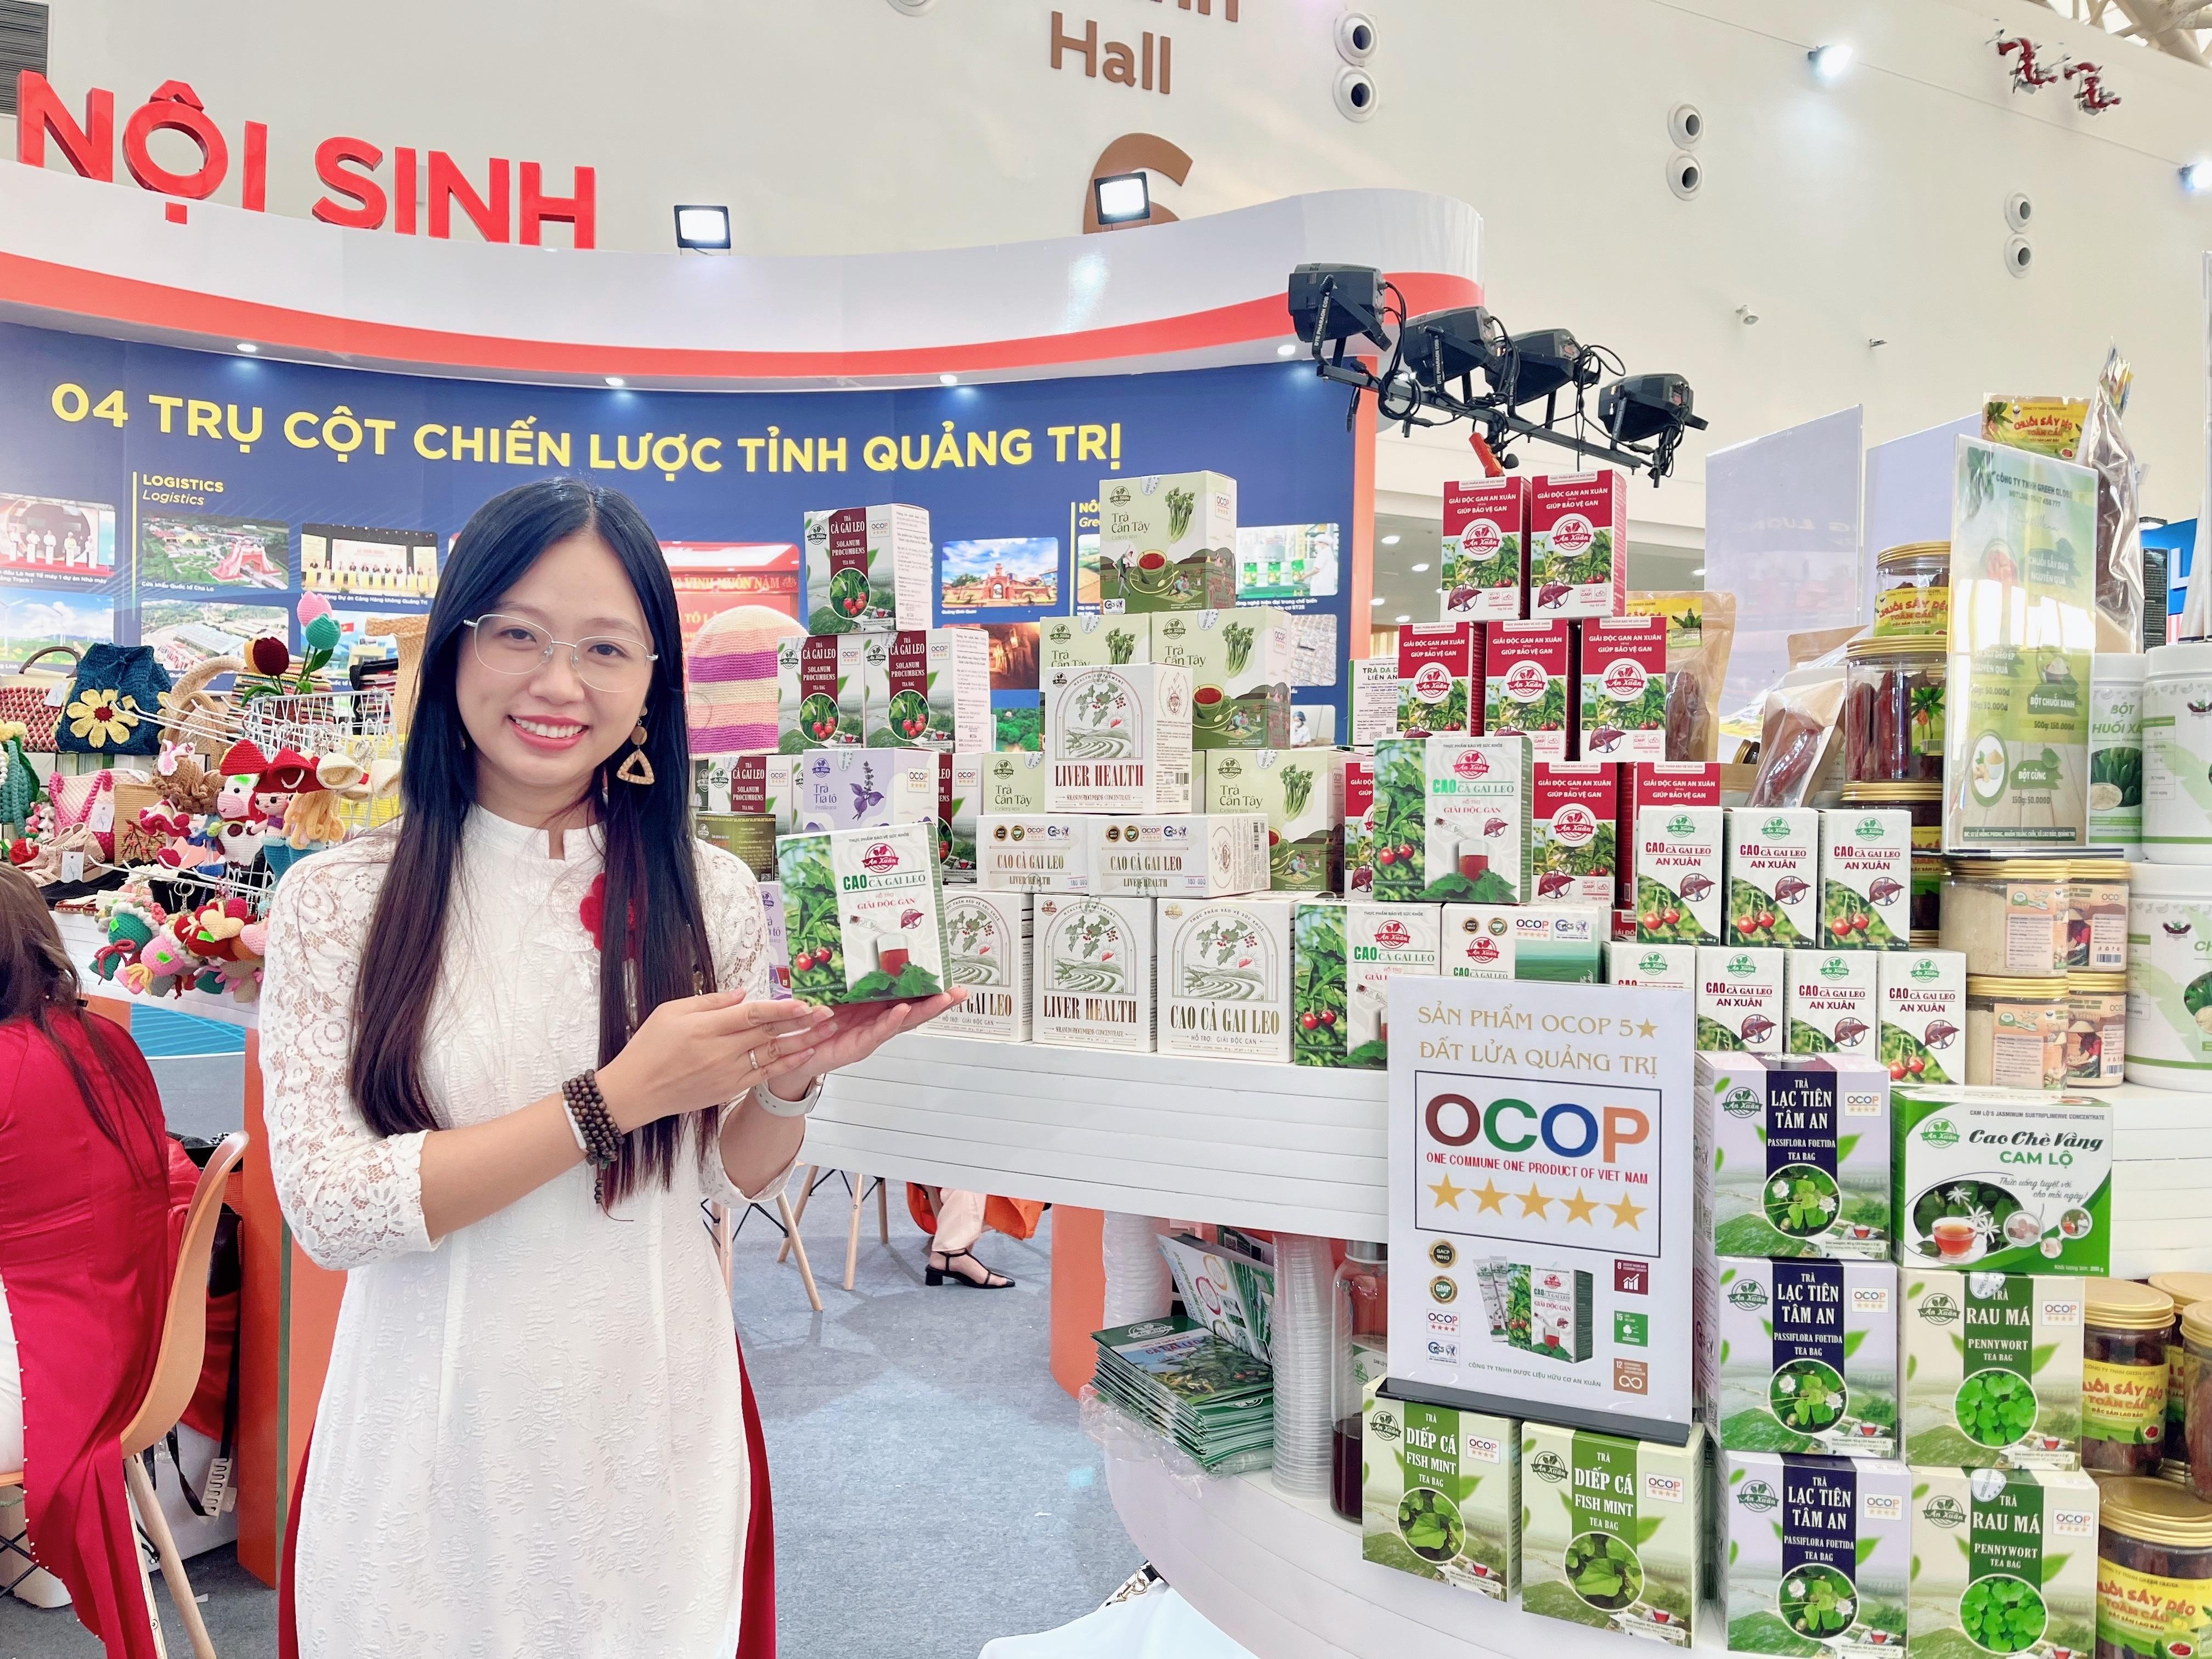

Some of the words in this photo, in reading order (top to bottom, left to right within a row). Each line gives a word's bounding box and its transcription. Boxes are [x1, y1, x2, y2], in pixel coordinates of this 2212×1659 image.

[1051, 11, 1171, 94] Hall
[17, 69, 267, 224] NỘI
[312, 137, 595, 249] SINH
[51, 382, 128, 428] 04
[148, 394, 262, 453] TRỤ
[284, 405, 395, 462] CỘT
[413, 416, 570, 467] CHIẾN
[590, 432, 722, 481] LƯỢC
[737, 426, 847, 472] TỈNH
[862, 421, 1032, 471] QUẢNG
[1047, 423, 1121, 470] TRỊ
[143, 473, 224, 493] LOGISTICS
[142, 489, 205, 506] Logistics
[1111, 512, 1129, 522] Trà
[831, 523, 839, 534] CÀ
[840, 523, 851, 534] GAI
[853, 521, 865, 532] LEO
[1111, 521, 1130, 533] Cần
[1131, 521, 1150, 534] Tây
[836, 539, 860, 548] SOLANUM
[832, 548, 865, 556] PROCUMBENS
[2030, 694, 2042, 708] BỘT
[2042, 693, 2059, 707] CHUỐI
[2111, 703, 2135, 717] BỘT
[1056, 765, 1090, 786] LIVER
[1095, 765, 1143, 787] HEALTH
[2018, 768, 2030, 782] BỘT
[814, 782, 829, 794] Trà
[814, 790, 827, 803] Tía
[828, 793, 837, 803] tô
[1646, 842, 1664, 853] CAO
[864, 857, 877, 866] An
[878, 856, 896, 864] Xuân
[1672, 857, 1701, 866] XUÂN
[843, 874, 867, 890] CAO
[869, 876, 883, 888] CÀ
[885, 876, 903, 886] GAI
[906, 874, 926, 883] LEO
[857, 900, 875, 910] GIẢI
[877, 900, 894, 909] ĐỘC
[1171, 1005, 1195, 1029] CAO
[1201, 1001, 1217, 1031] CÀ
[1223, 1008, 1246, 1032] GAI
[1252, 1010, 1279, 1035] LEO
[1418, 1001, 1461, 1026] SẢN
[1471, 1003, 1533, 1030] PHẨM
[1542, 1014, 1611, 1035] OCOP
[1620, 1019, 1633, 1036] 5
[1419, 1036, 1463, 1060] ĐẤT
[1472, 1039, 1517, 1064] LỬA
[1526, 1044, 1610, 1071] QUẢNG
[1620, 1055, 1657, 1079] TRỊ
[1795, 1078, 1808, 1088] TRÀ
[1771, 1091, 1796, 1108] LẠC
[1801, 1088, 1832, 1107] TIÊN
[1847, 1096, 1879, 1104] OCOP
[1775, 1110, 1804, 1128] TÂM
[1810, 1113, 1827, 1129] AN
[1425, 1093, 1650, 1163] OCOP
[1768, 1138, 1806, 1147] PASSIFLORA
[1808, 1139, 1836, 1148] FOETIDA
[1969, 1129, 2008, 1145] Cao
[2012, 1131, 2050, 1147] Chè
[2055, 1131, 2103, 1152] Vằng
[2000, 1151, 2041, 1164] CAM
[2050, 1150, 2073, 1169] LỘ
[1426, 1152, 1447, 1165] ONE
[1449, 1154, 1500, 1170] COMMUNE
[1504, 1160, 1525, 1172] ONE
[1529, 1163, 1577, 1178] PRODUCT
[1581, 1167, 1595, 1178] OF
[1599, 1169, 1620, 1182] VIET
[1625, 1172, 1648, 1184] NAM
[2000, 1177, 2017, 1186] Thức
[2019, 1178, 2038, 1190] uống
[2039, 1180, 2059, 1190] tuyệt
[2033, 1189, 2046, 1198] cho
[2048, 1190, 2061, 1199] mỗi
[2063, 1192, 2088, 1202] ngày!
[1428, 1313, 1458, 1323] OCOP
[1597, 1452, 1611, 1463] TRÀ
[1575, 1465, 1611, 1492] DIẾP
[1615, 1473, 1634, 1495] CÁ
[1649, 1477, 1680, 1489] OCOP
[1575, 1494, 1601, 1511] FISH
[1604, 1498, 1633, 1517] MINT
[2000, 1494, 2017, 1507] TRÀ
[1973, 1511, 2008, 1531] RAU
[2014, 1513, 2041, 1534] MÁ
[2056, 1514, 2091, 1525] OCOP
[1974, 1543, 2038, 1559] PENNYWORT
